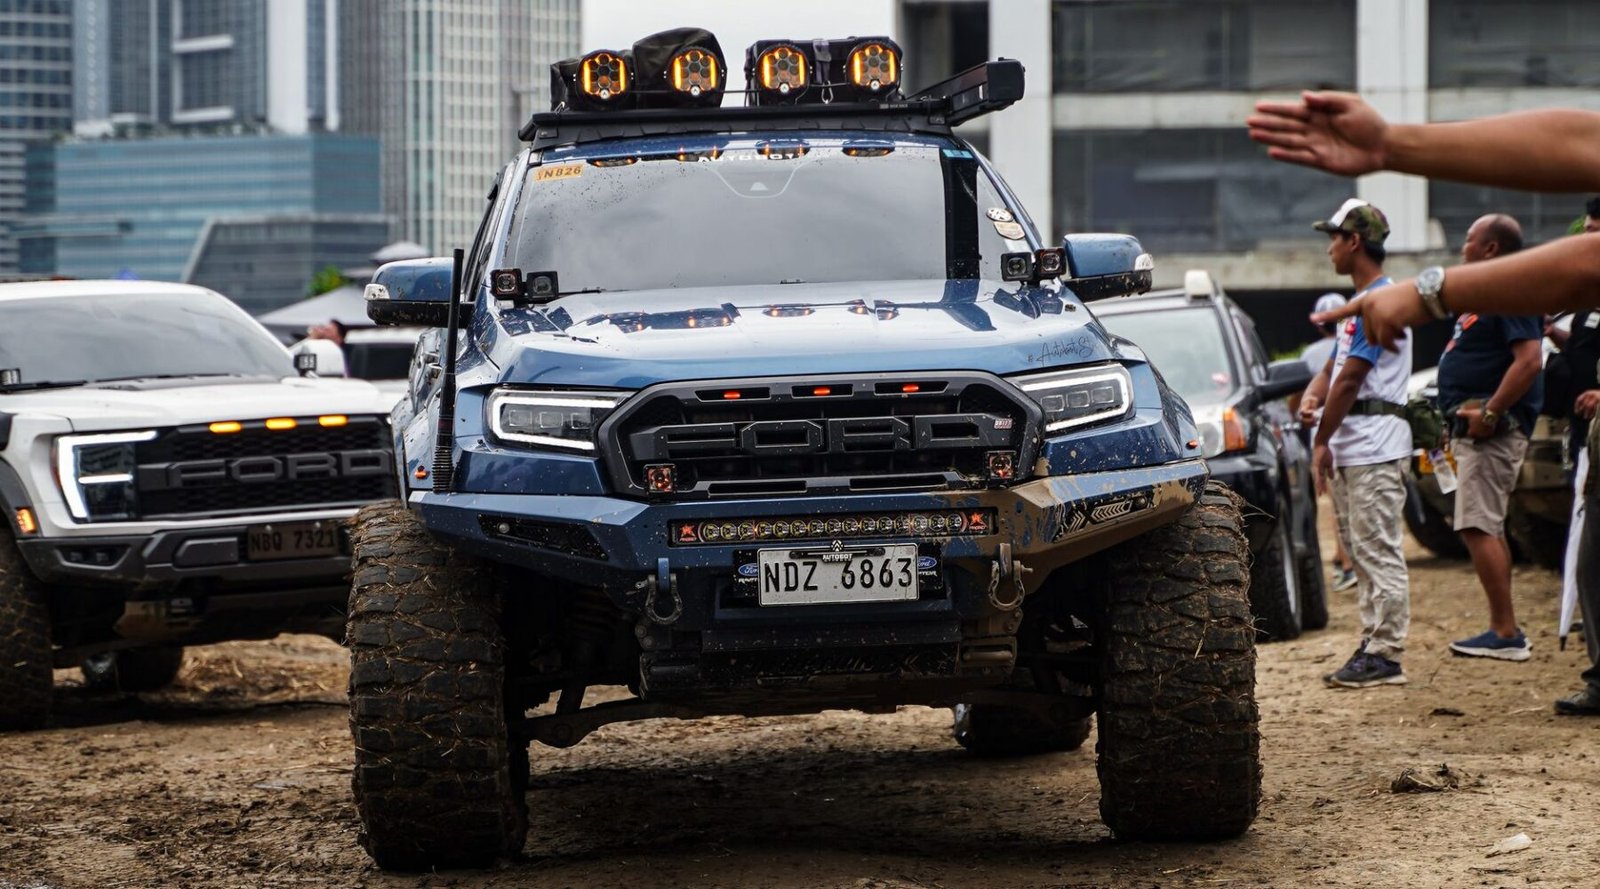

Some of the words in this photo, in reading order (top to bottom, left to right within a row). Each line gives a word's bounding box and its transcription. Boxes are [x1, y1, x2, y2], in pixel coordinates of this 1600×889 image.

[645, 412, 998, 460] FORD
[167, 449, 391, 489] FORD
[251, 531, 282, 552] NBQ
[293, 528, 335, 550] 7321
[764, 561, 818, 593] NDZ
[841, 557, 912, 590] 6863
